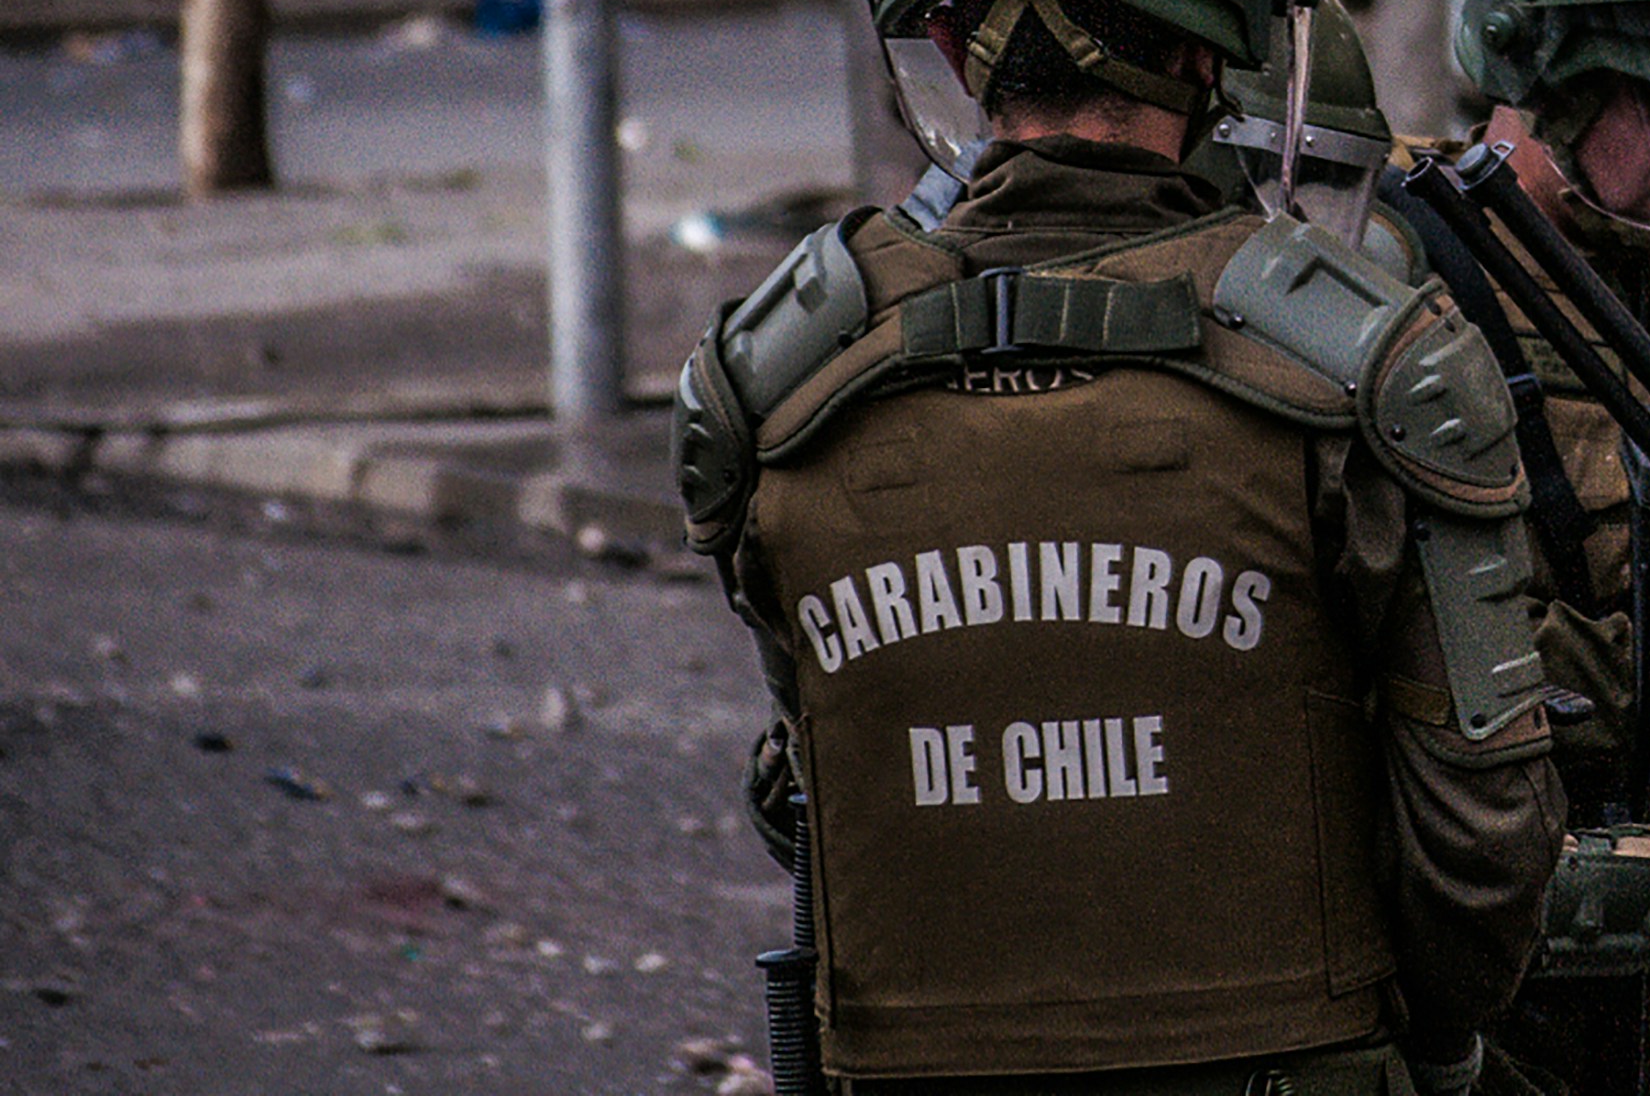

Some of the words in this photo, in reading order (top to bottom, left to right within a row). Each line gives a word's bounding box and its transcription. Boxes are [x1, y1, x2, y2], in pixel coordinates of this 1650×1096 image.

[797, 541, 1272, 675] CARABINEROS
[908, 724, 982, 806] DE
[1001, 715, 1169, 803] CHILE
